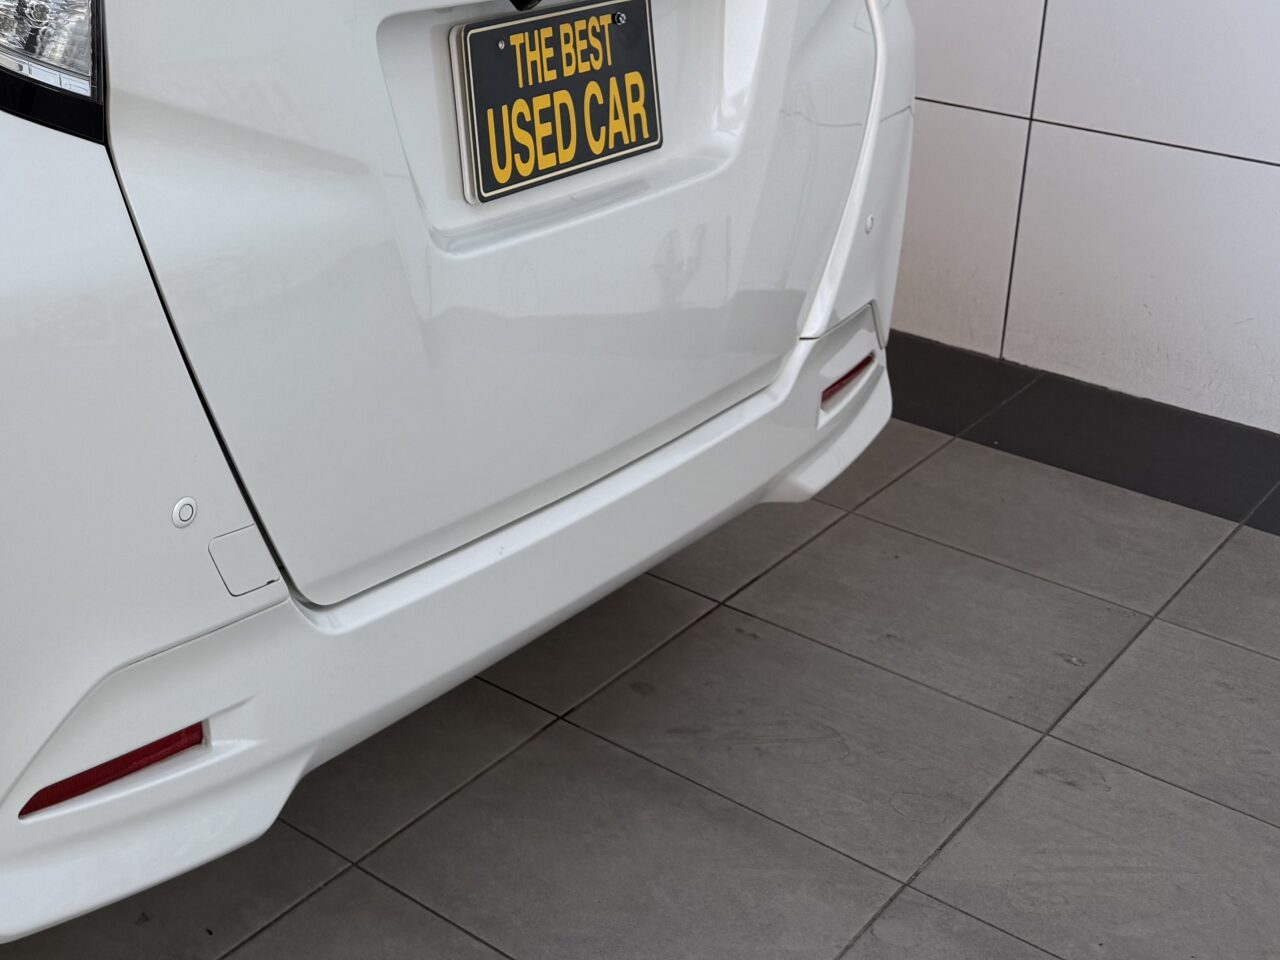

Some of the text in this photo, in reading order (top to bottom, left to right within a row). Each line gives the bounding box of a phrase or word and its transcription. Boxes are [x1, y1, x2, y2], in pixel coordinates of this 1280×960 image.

[509, 14, 613, 88] THE BEST
[486, 71, 650, 184] USED CAR
